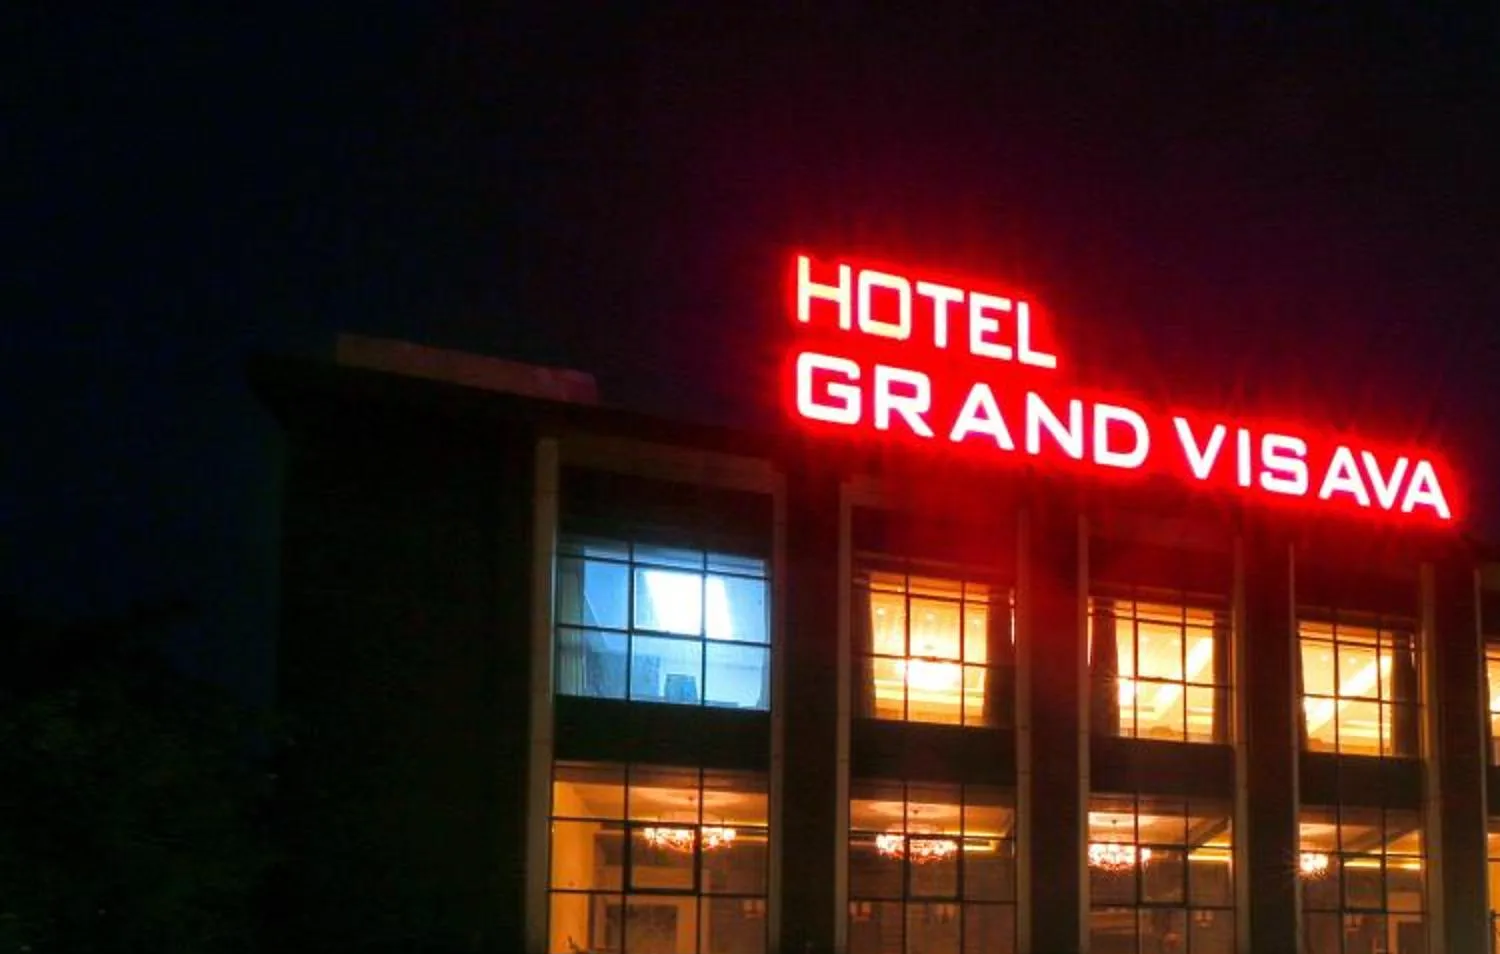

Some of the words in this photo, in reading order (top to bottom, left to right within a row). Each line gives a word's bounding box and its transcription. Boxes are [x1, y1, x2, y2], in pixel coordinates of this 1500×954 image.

[796, 256, 1057, 368] HOTEL
[796, 351, 1150, 470] GRAND
[1173, 416, 1451, 519] VISAVA
